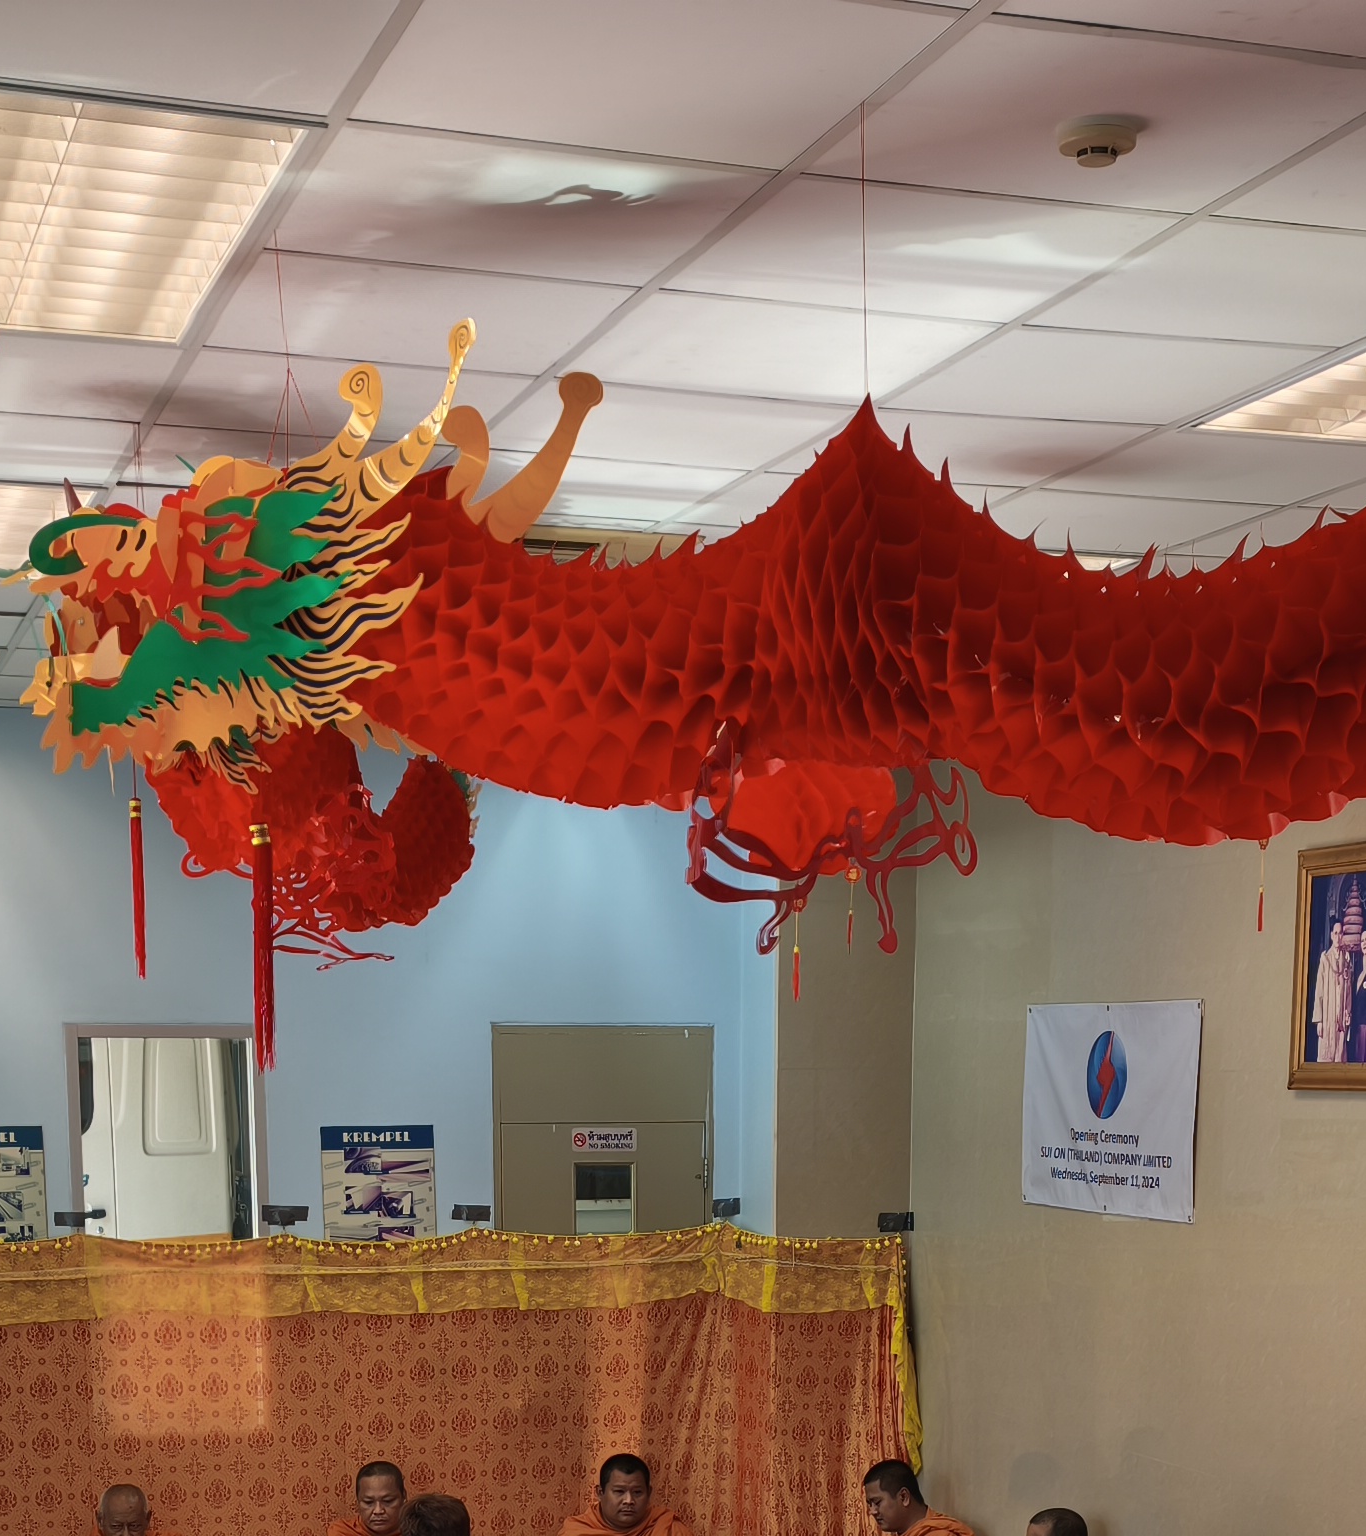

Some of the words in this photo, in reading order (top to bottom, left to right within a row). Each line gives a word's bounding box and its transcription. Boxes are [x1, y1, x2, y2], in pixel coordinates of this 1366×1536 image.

[343, 1131, 411, 1143] KREMPEL
[600, 1142, 633, 1150] SMOKING
[1070, 1127, 1099, 1146] Opening
[1100, 1129, 1139, 1148] Ceremony
[1054, 1147, 1066, 1159] ON
[1067, 1148, 1102, 1166] (THAILAND)
[1103, 1151, 1142, 1166] COMPANY
[1143, 1155, 1172, 1169] LIMITED
[1090, 1171, 1129, 1186] September
[1130, 1175, 1140, 1189] 11,
[1141, 1175, 1160, 1189] 2024
